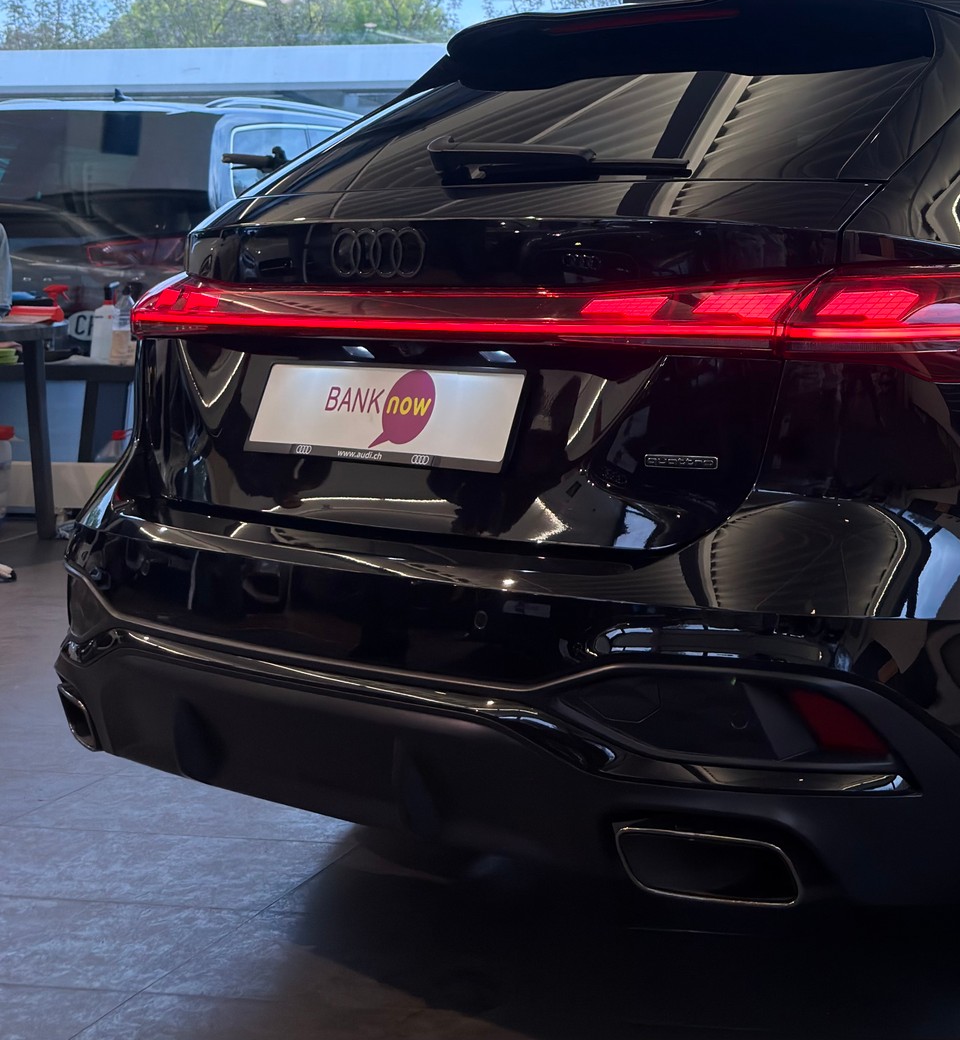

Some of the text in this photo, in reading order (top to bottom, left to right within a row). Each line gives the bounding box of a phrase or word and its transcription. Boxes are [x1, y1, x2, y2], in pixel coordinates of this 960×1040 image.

[324, 386, 432, 417] BANK now
[337, 449, 383, 461] www.audi.ch
